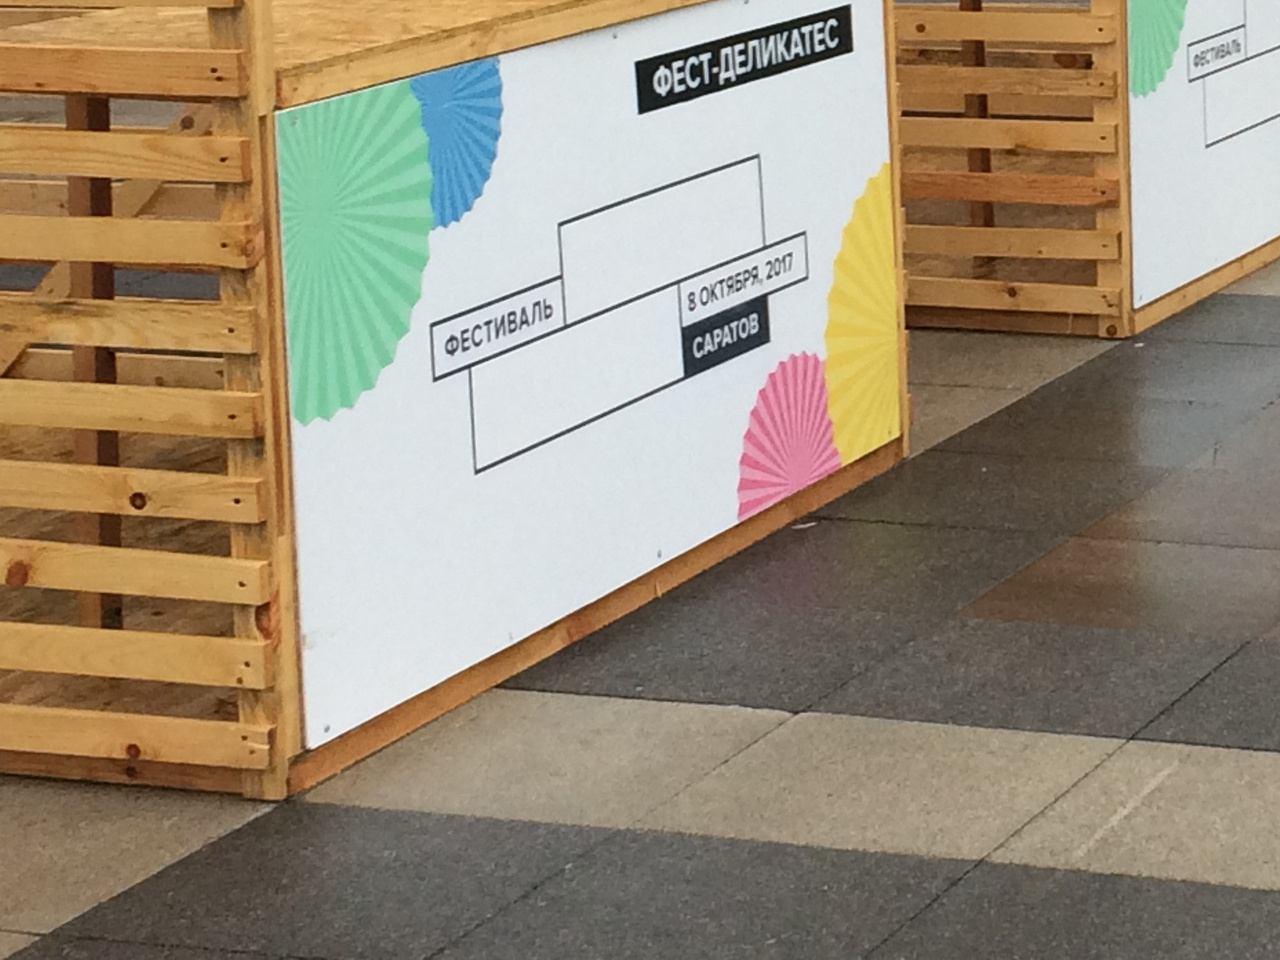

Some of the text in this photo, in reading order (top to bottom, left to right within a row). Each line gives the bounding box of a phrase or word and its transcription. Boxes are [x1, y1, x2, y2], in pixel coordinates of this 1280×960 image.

[652, 18, 839, 97] ФЕСТ-ДЕЛИКАТЕС
[686, 251, 795, 313] 8 ОКТЯБРЯ, 2017
[443, 298, 555, 359] ФЕСТИВАЛЬ
[691, 312, 760, 360] САРАТОВ
